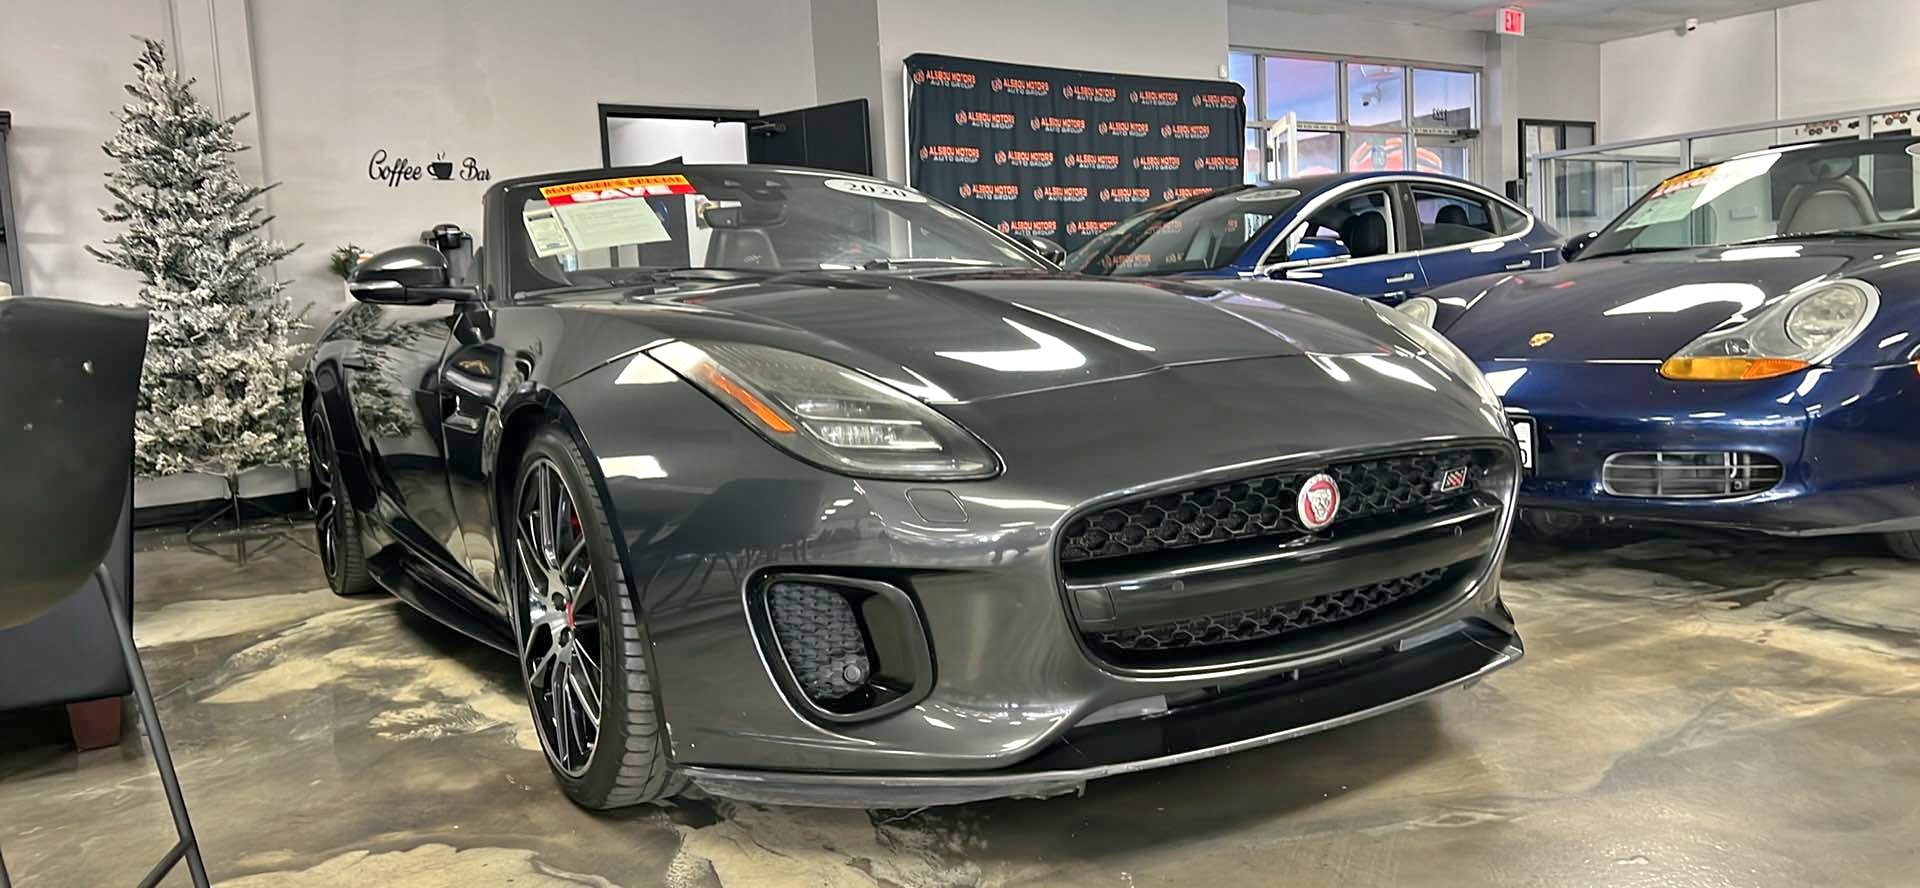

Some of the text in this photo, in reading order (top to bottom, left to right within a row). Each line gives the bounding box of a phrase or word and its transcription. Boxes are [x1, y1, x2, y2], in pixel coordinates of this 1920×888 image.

[952, 72, 976, 84] MOTORS
[1026, 80, 1049, 91] MOTORS
[1095, 88, 1116, 98] MOTORS
[1158, 92, 1178, 102] MOTORS
[992, 113, 1015, 124] MOTORS
[1062, 119, 1085, 129] MOTORS
[1191, 125, 1210, 134] MOTORS
[956, 148, 979, 158] MOTORS
[1030, 152, 1053, 162] MOTORS
[1098, 155, 1119, 165] MOTORS
[1161, 156, 1180, 166] MOTORS
[368, 149, 491, 187] Coffee Bar
[628, 176, 682, 186] SPECIAL
[572, 186, 673, 202] SAVE
[848, 183, 906, 196] 2020
[994, 185, 1018, 196] MOTORS
[1064, 187, 1088, 197] MOTORS
[1034, 222, 1056, 231] MOTORS
